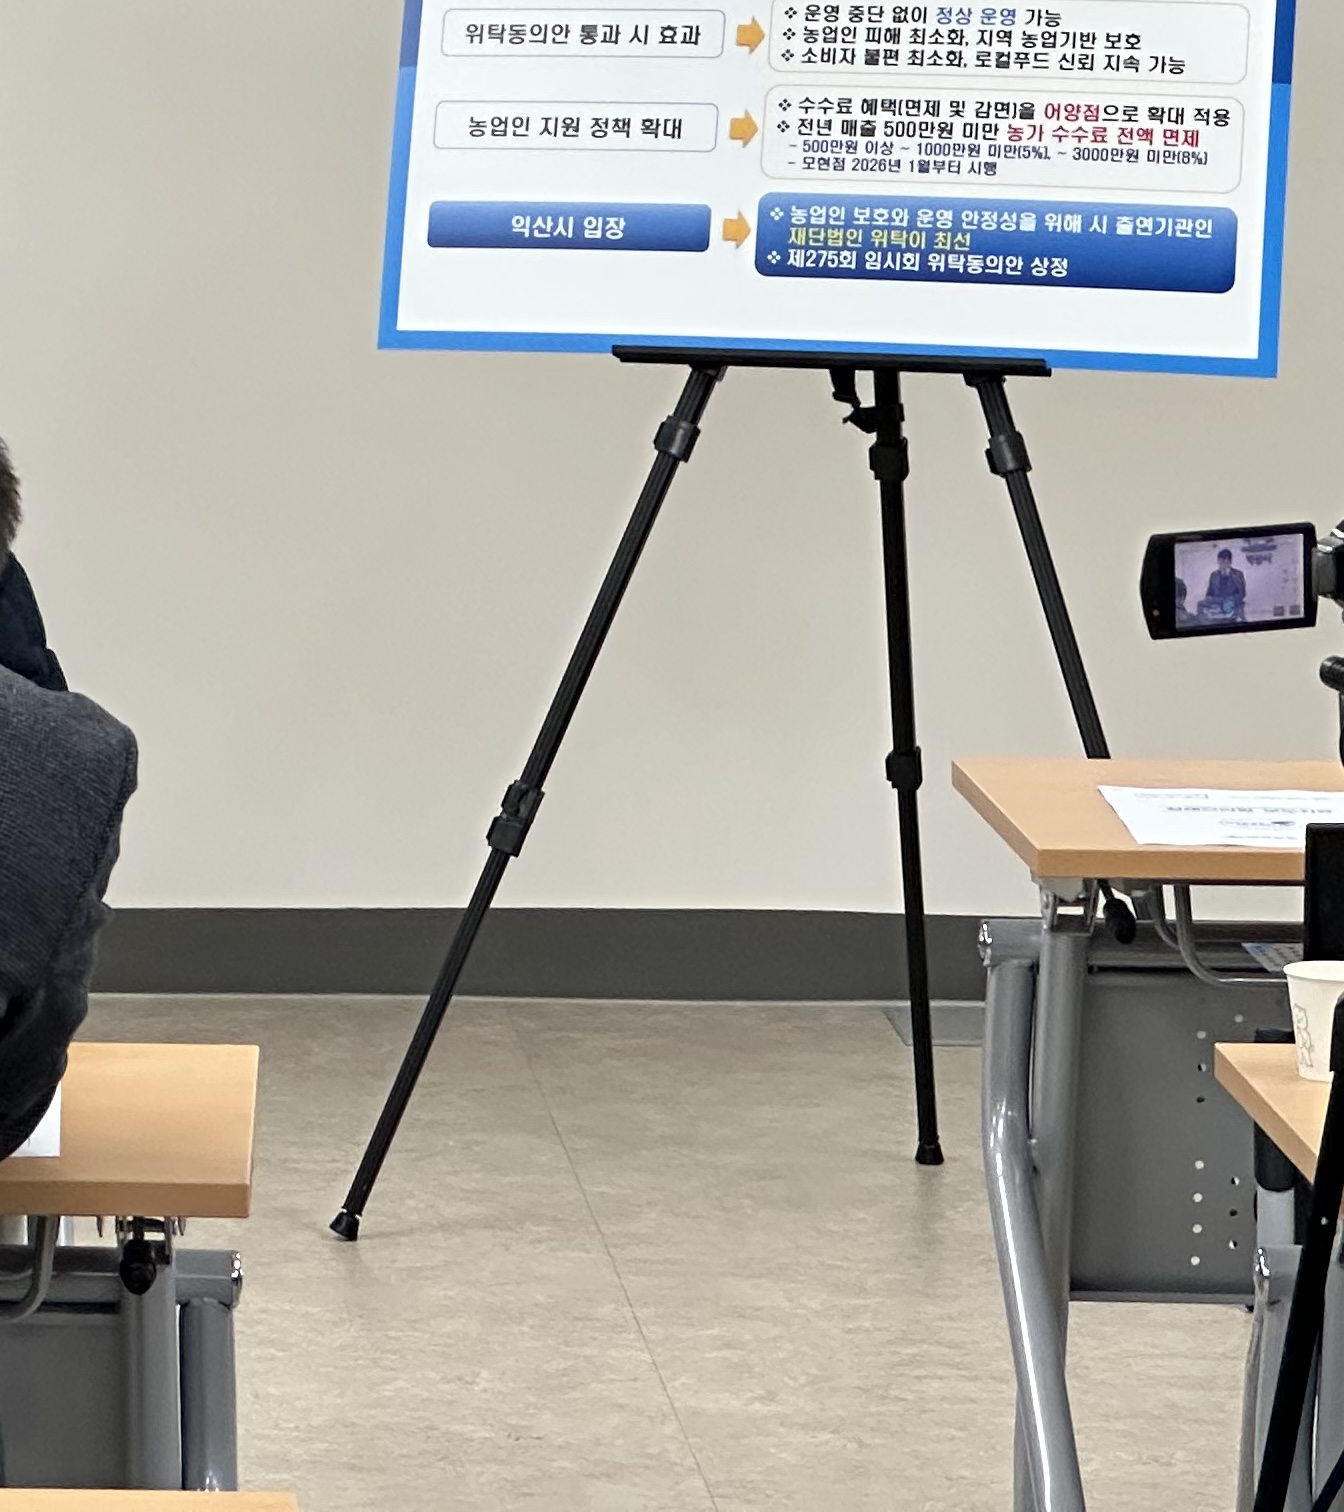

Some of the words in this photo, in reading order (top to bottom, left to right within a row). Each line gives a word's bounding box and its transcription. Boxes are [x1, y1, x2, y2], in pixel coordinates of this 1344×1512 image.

[804, 4, 840, 25] 운영
[848, 5, 885, 26] 중단
[892, 5, 928, 24] 없이
[980, 7, 1016, 27] 운영
[1024, 8, 1062, 28] 가능
[466, 24, 571, 45] 위탁동의안
[579, 24, 621, 45] 통과
[628, 24, 649, 45] 시
[658, 25, 701, 46] 효과
[803, 25, 857, 44] 농업인
[976, 29, 1013, 48] 지역
[1021, 30, 1097, 50] 농업기반
[864, 48, 899, 67] 불편
[974, 51, 1050, 70] 로컬푸드
[1103, 54, 1140, 73] 지속
[1148, 55, 1186, 75] 가능
[798, 97, 853, 119] 수수료
[948, 100, 966, 122] 및
[1044, 103, 1139, 123] 어양점으로
[1147, 106, 1185, 125] 확대
[1193, 108, 1231, 127] 적용
[468, 116, 530, 137] 농업인
[539, 117, 580, 138] 지원
[590, 117, 631, 139] 정책
[640, 118, 683, 139] 확대
[797, 118, 833, 139] 전년
[840, 119, 877, 140] 매출
[883, 120, 954, 143] 500만원
[962, 122, 1000, 144] 미만
[1007, 124, 1044, 145] 농가
[1052, 125, 1108, 147] 수수료
[1117, 127, 1154, 149] 전액
[1163, 128, 1200, 150] 면제
[802, 139, 859, 158] 500만원
[863, 140, 894, 159] 이상
[917, 142, 981, 161] 1000만원
[967, 158, 997, 177] 시행
[511, 215, 574, 238] 익산시
[583, 216, 626, 240] 입장
[790, 205, 846, 228] 농업인
[852, 207, 910, 230] 보호와
[916, 208, 953, 232] 운영
[961, 210, 1037, 234] 안정성을
[1044, 212, 1082, 233] 위해
[1089, 214, 1108, 234] 시
[1115, 216, 1213, 238] 출연기관인
[788, 227, 863, 249] 재단법인
[870, 229, 926, 251] 위탁이
[933, 231, 971, 251] 최선
[786, 248, 857, 269] 제275회
[864, 251, 920, 271] 임시회
[927, 253, 1024, 275] 위탁동의안
[1030, 257, 1068, 278] 상정
